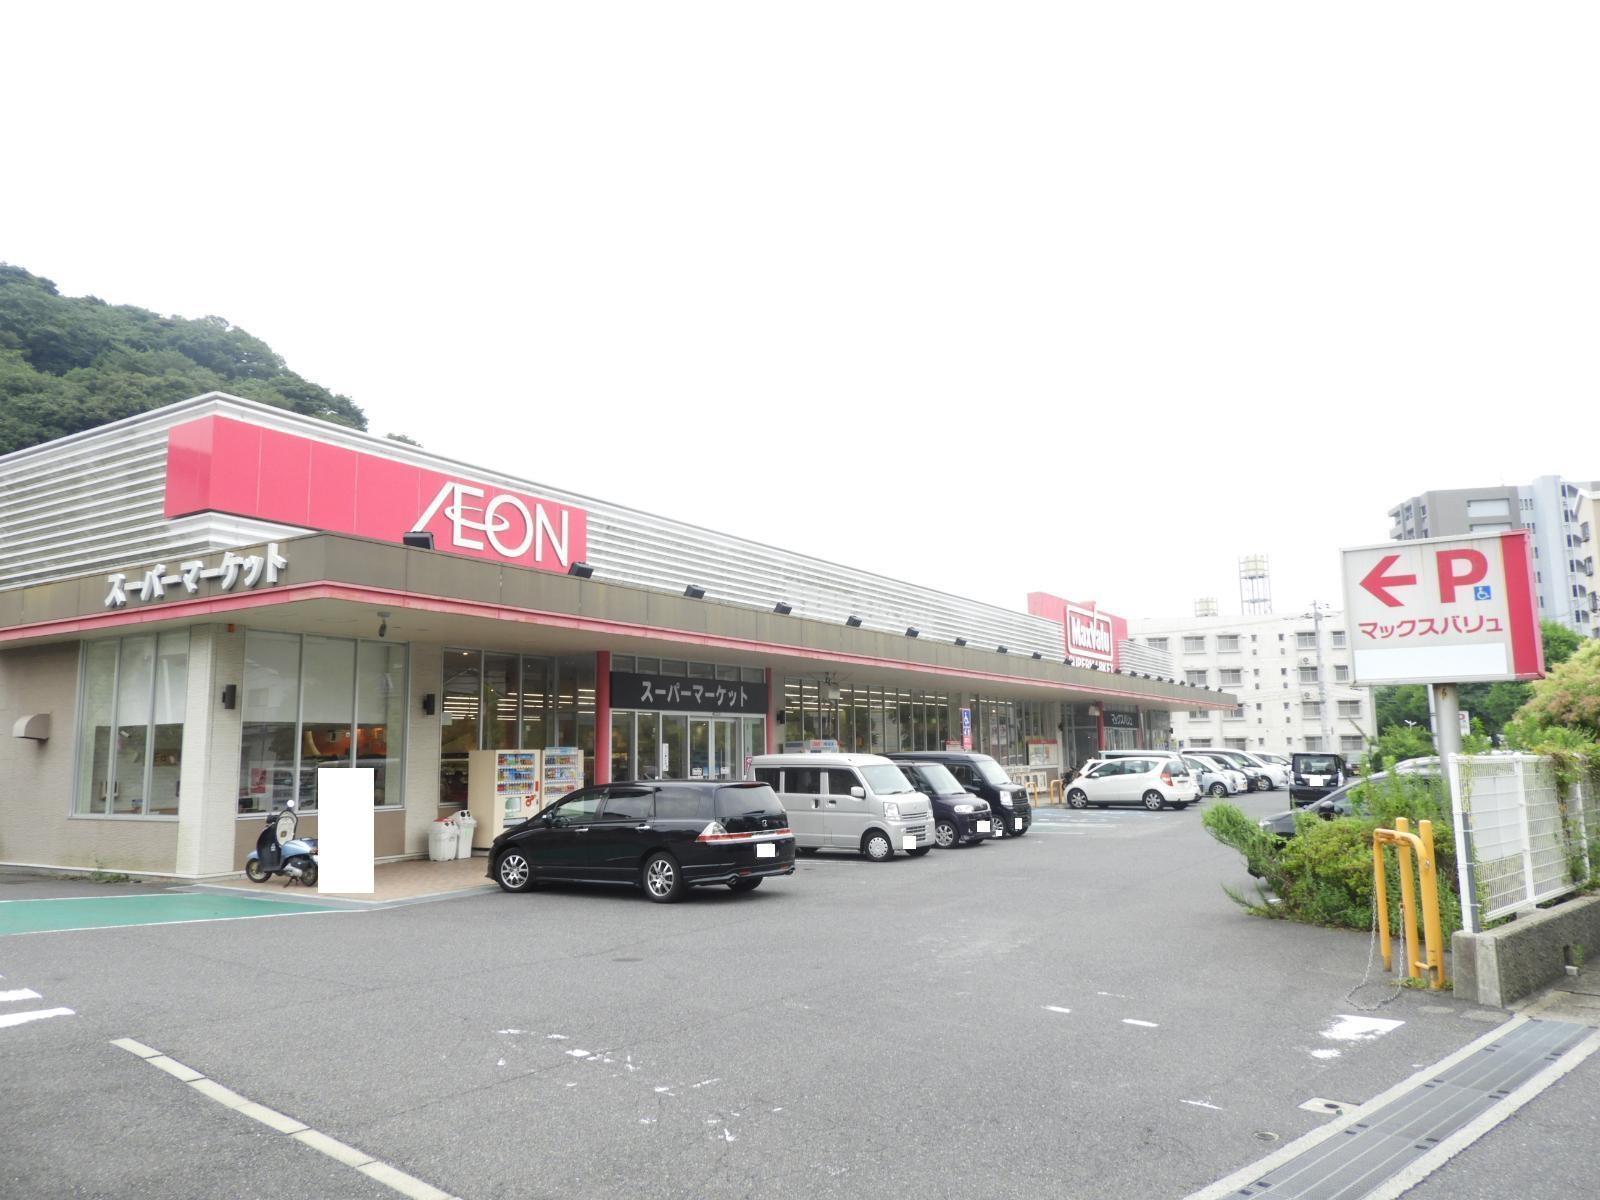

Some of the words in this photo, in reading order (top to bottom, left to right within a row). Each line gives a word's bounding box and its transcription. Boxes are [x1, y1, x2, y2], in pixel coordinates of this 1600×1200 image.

[104, 543, 288, 608] スーパーマーケット
[1435, 549, 1488, 603] P
[1070, 611, 1110, 653] MaxValu
[1358, 615, 1503, 640] マックスバリュ
[640, 681, 748, 707] スーパーマーケット
